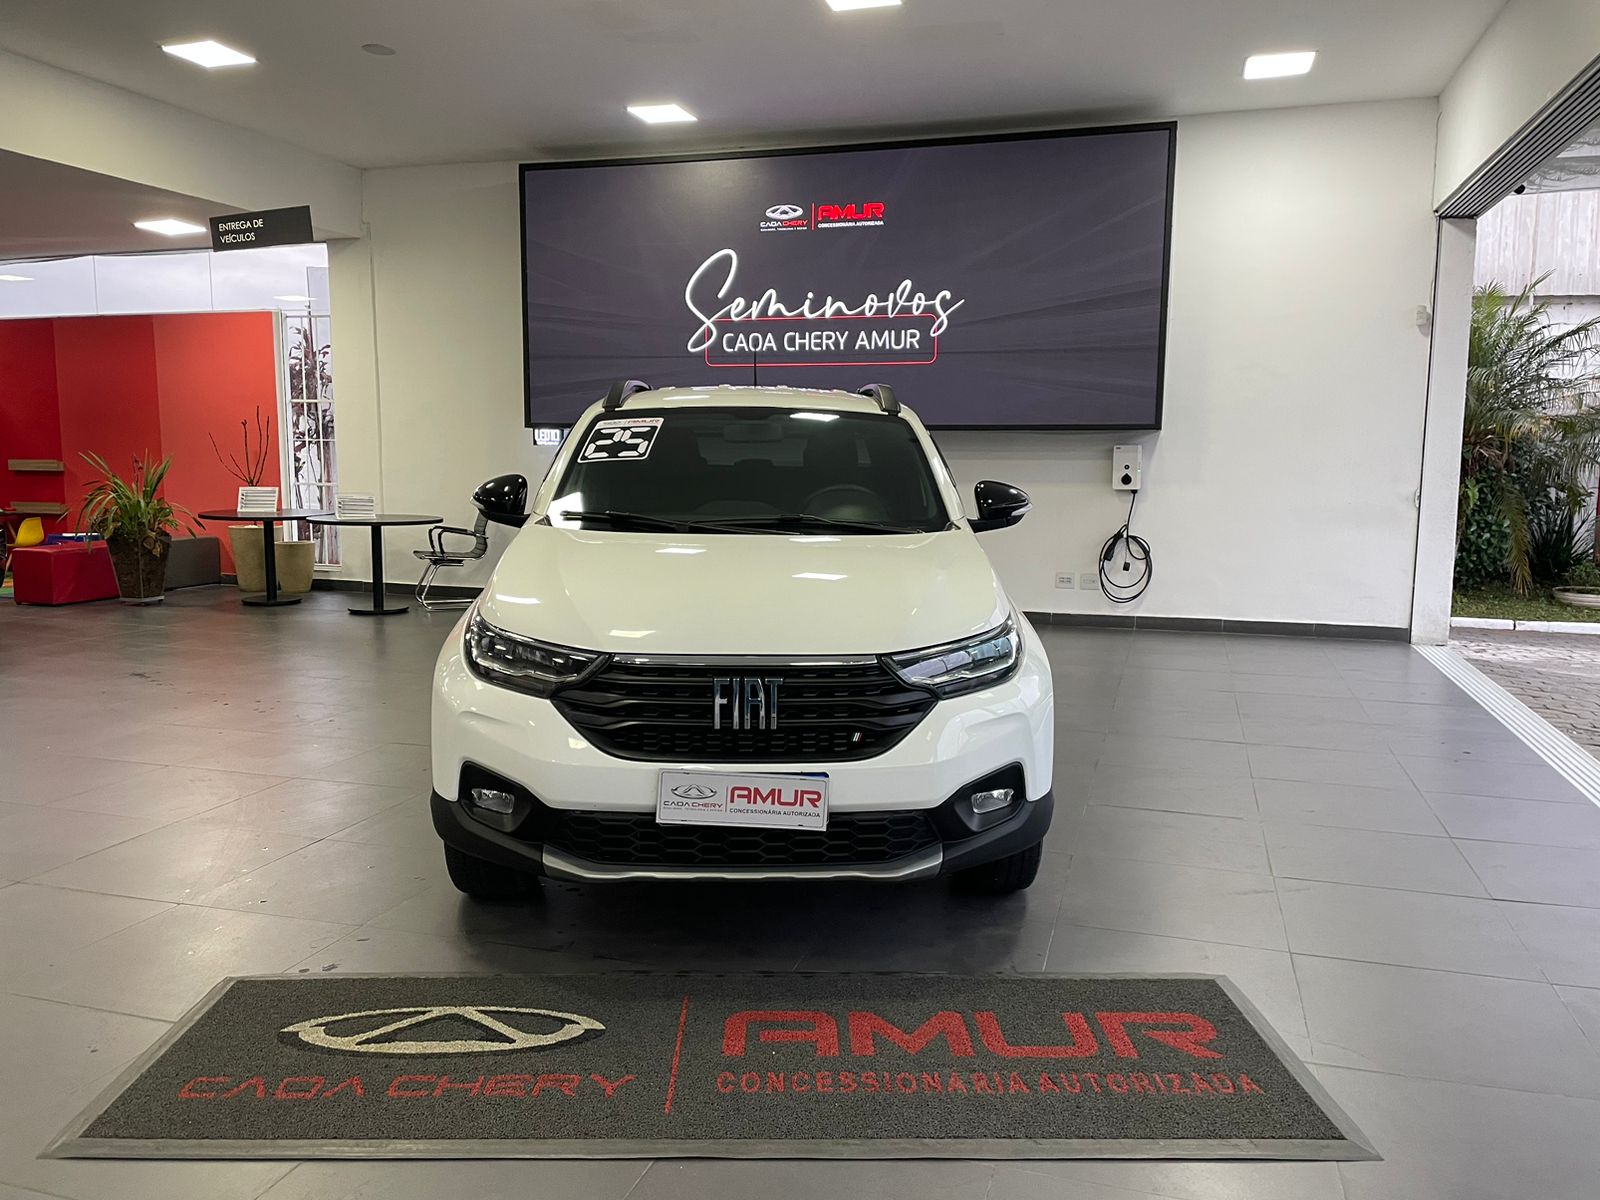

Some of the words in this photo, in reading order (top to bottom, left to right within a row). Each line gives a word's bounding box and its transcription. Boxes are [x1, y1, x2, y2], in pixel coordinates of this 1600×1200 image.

[817, 203, 885, 220] AMUR
[218, 220, 252, 232] ENTREGA
[253, 219, 264, 228] DE
[220, 232, 256, 243] VEÍCULOS
[685, 248, 965, 352] Seminovos
[722, 332, 777, 352] CAOA
[783, 331, 849, 351] CHERY
[855, 329, 920, 350] AMUR
[584, 428, 652, 459] 25
[713, 677, 784, 730] FIAT
[729, 786, 822, 808] AMUR
[782, 810, 821, 818] AUTORIZADA
[722, 1010, 1223, 1058] AMUR
[178, 1075, 366, 1101] CAOA
[386, 1073, 636, 1099] CHERY
[1038, 1070, 1267, 1097] AUTORIZADA
